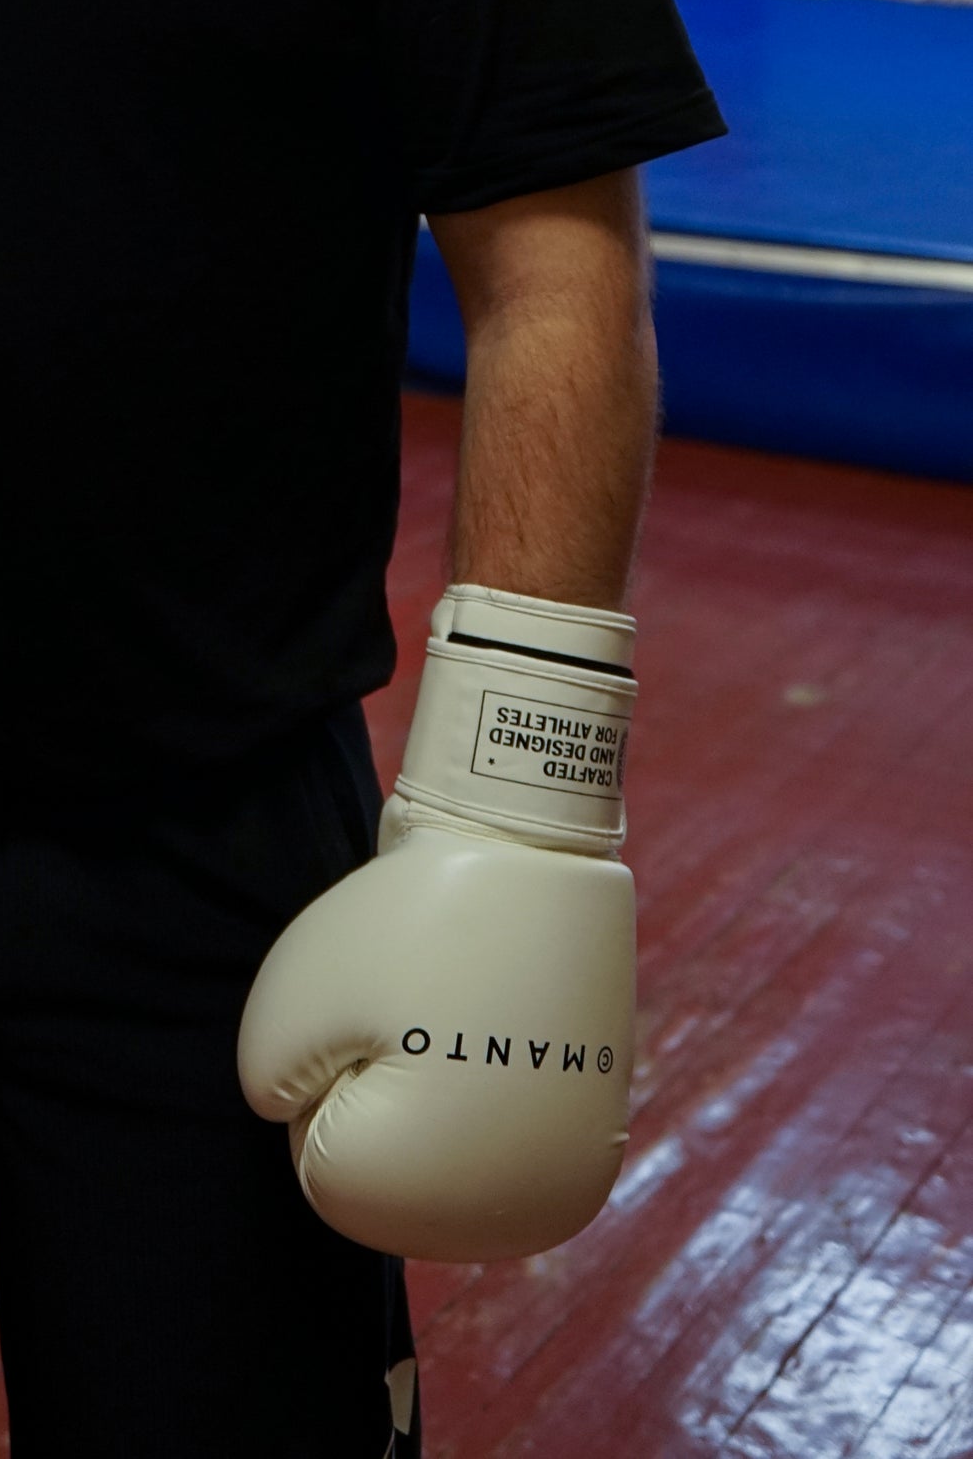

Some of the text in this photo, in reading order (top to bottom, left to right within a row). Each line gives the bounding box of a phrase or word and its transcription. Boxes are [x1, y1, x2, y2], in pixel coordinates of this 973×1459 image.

[496, 707, 618, 744] FOR ATHLETES
[489, 727, 616, 766] AND DESIGNED
[543, 760, 613, 787] CRAFTED
